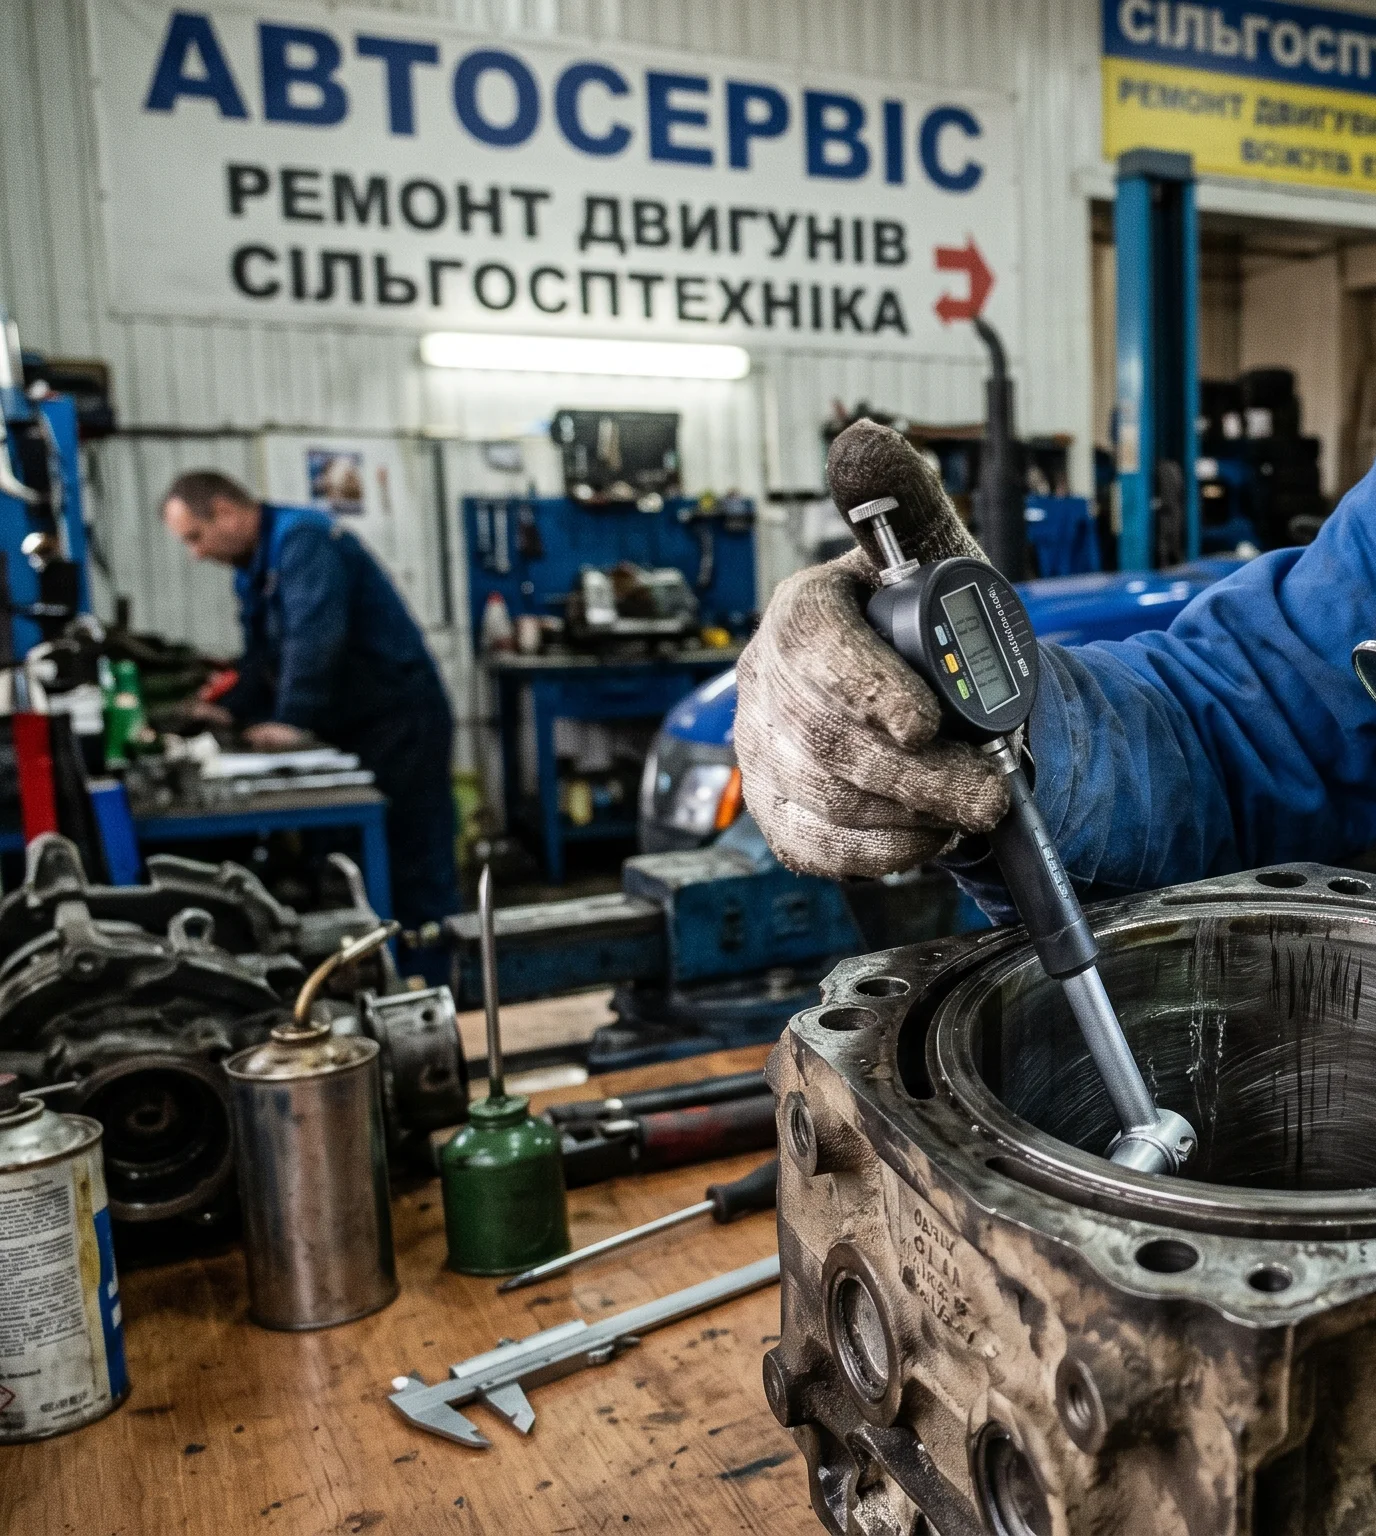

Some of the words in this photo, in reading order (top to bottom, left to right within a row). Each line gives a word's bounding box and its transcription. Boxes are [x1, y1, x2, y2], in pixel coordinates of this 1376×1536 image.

[143, 8, 984, 193] АВТОСЕРВІС
[226, 162, 550, 240] РЕМОНТ
[579, 195, 909, 268] ДВИГУНІВ
[230, 242, 910, 337] СІЛЬГОСПТЕХНІКА
